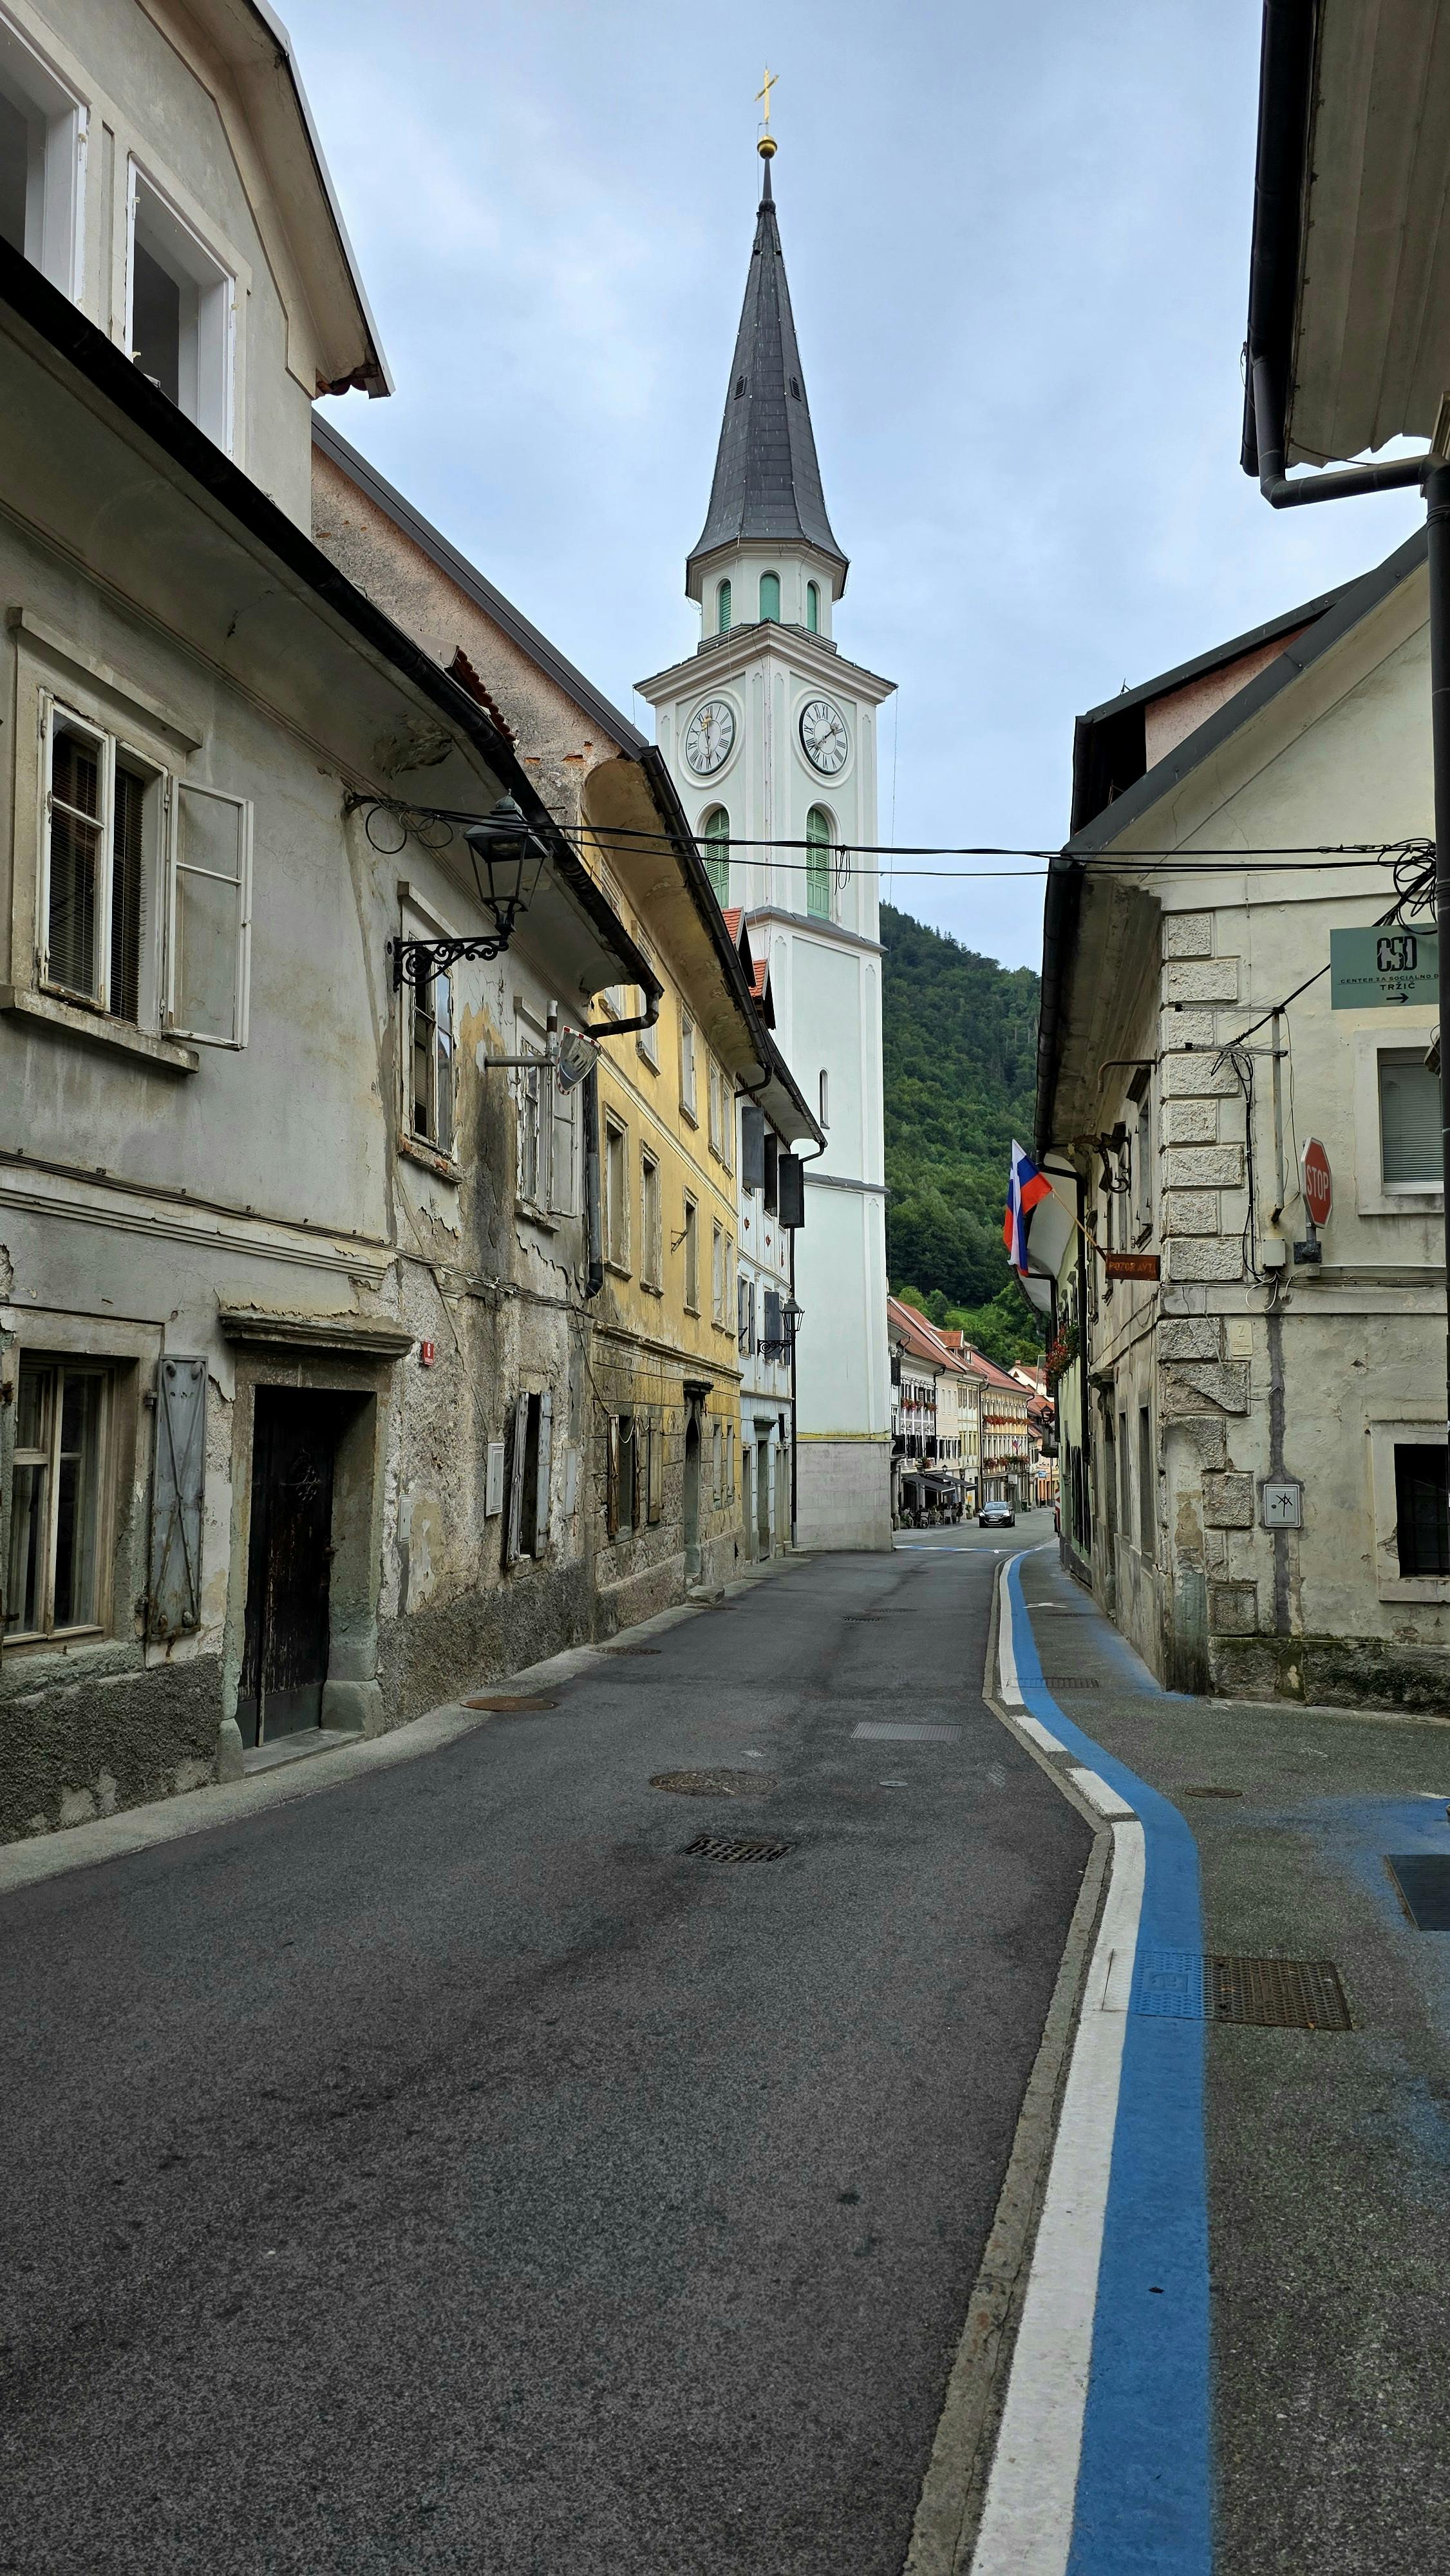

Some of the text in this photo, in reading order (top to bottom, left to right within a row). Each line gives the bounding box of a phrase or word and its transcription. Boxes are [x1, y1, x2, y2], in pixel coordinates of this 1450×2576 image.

[806, 712, 816, 725] X
[813, 705, 821, 720] XI
[690, 728, 700, 736] X
[1377, 936, 1418, 972] CSD
[1380, 981, 1416, 990] TRŽIČ
[1306, 1164, 1329, 1202] STOP
[1109, 1262, 1136, 1272] POZOR
[427, 1343, 431, 1357] 6
